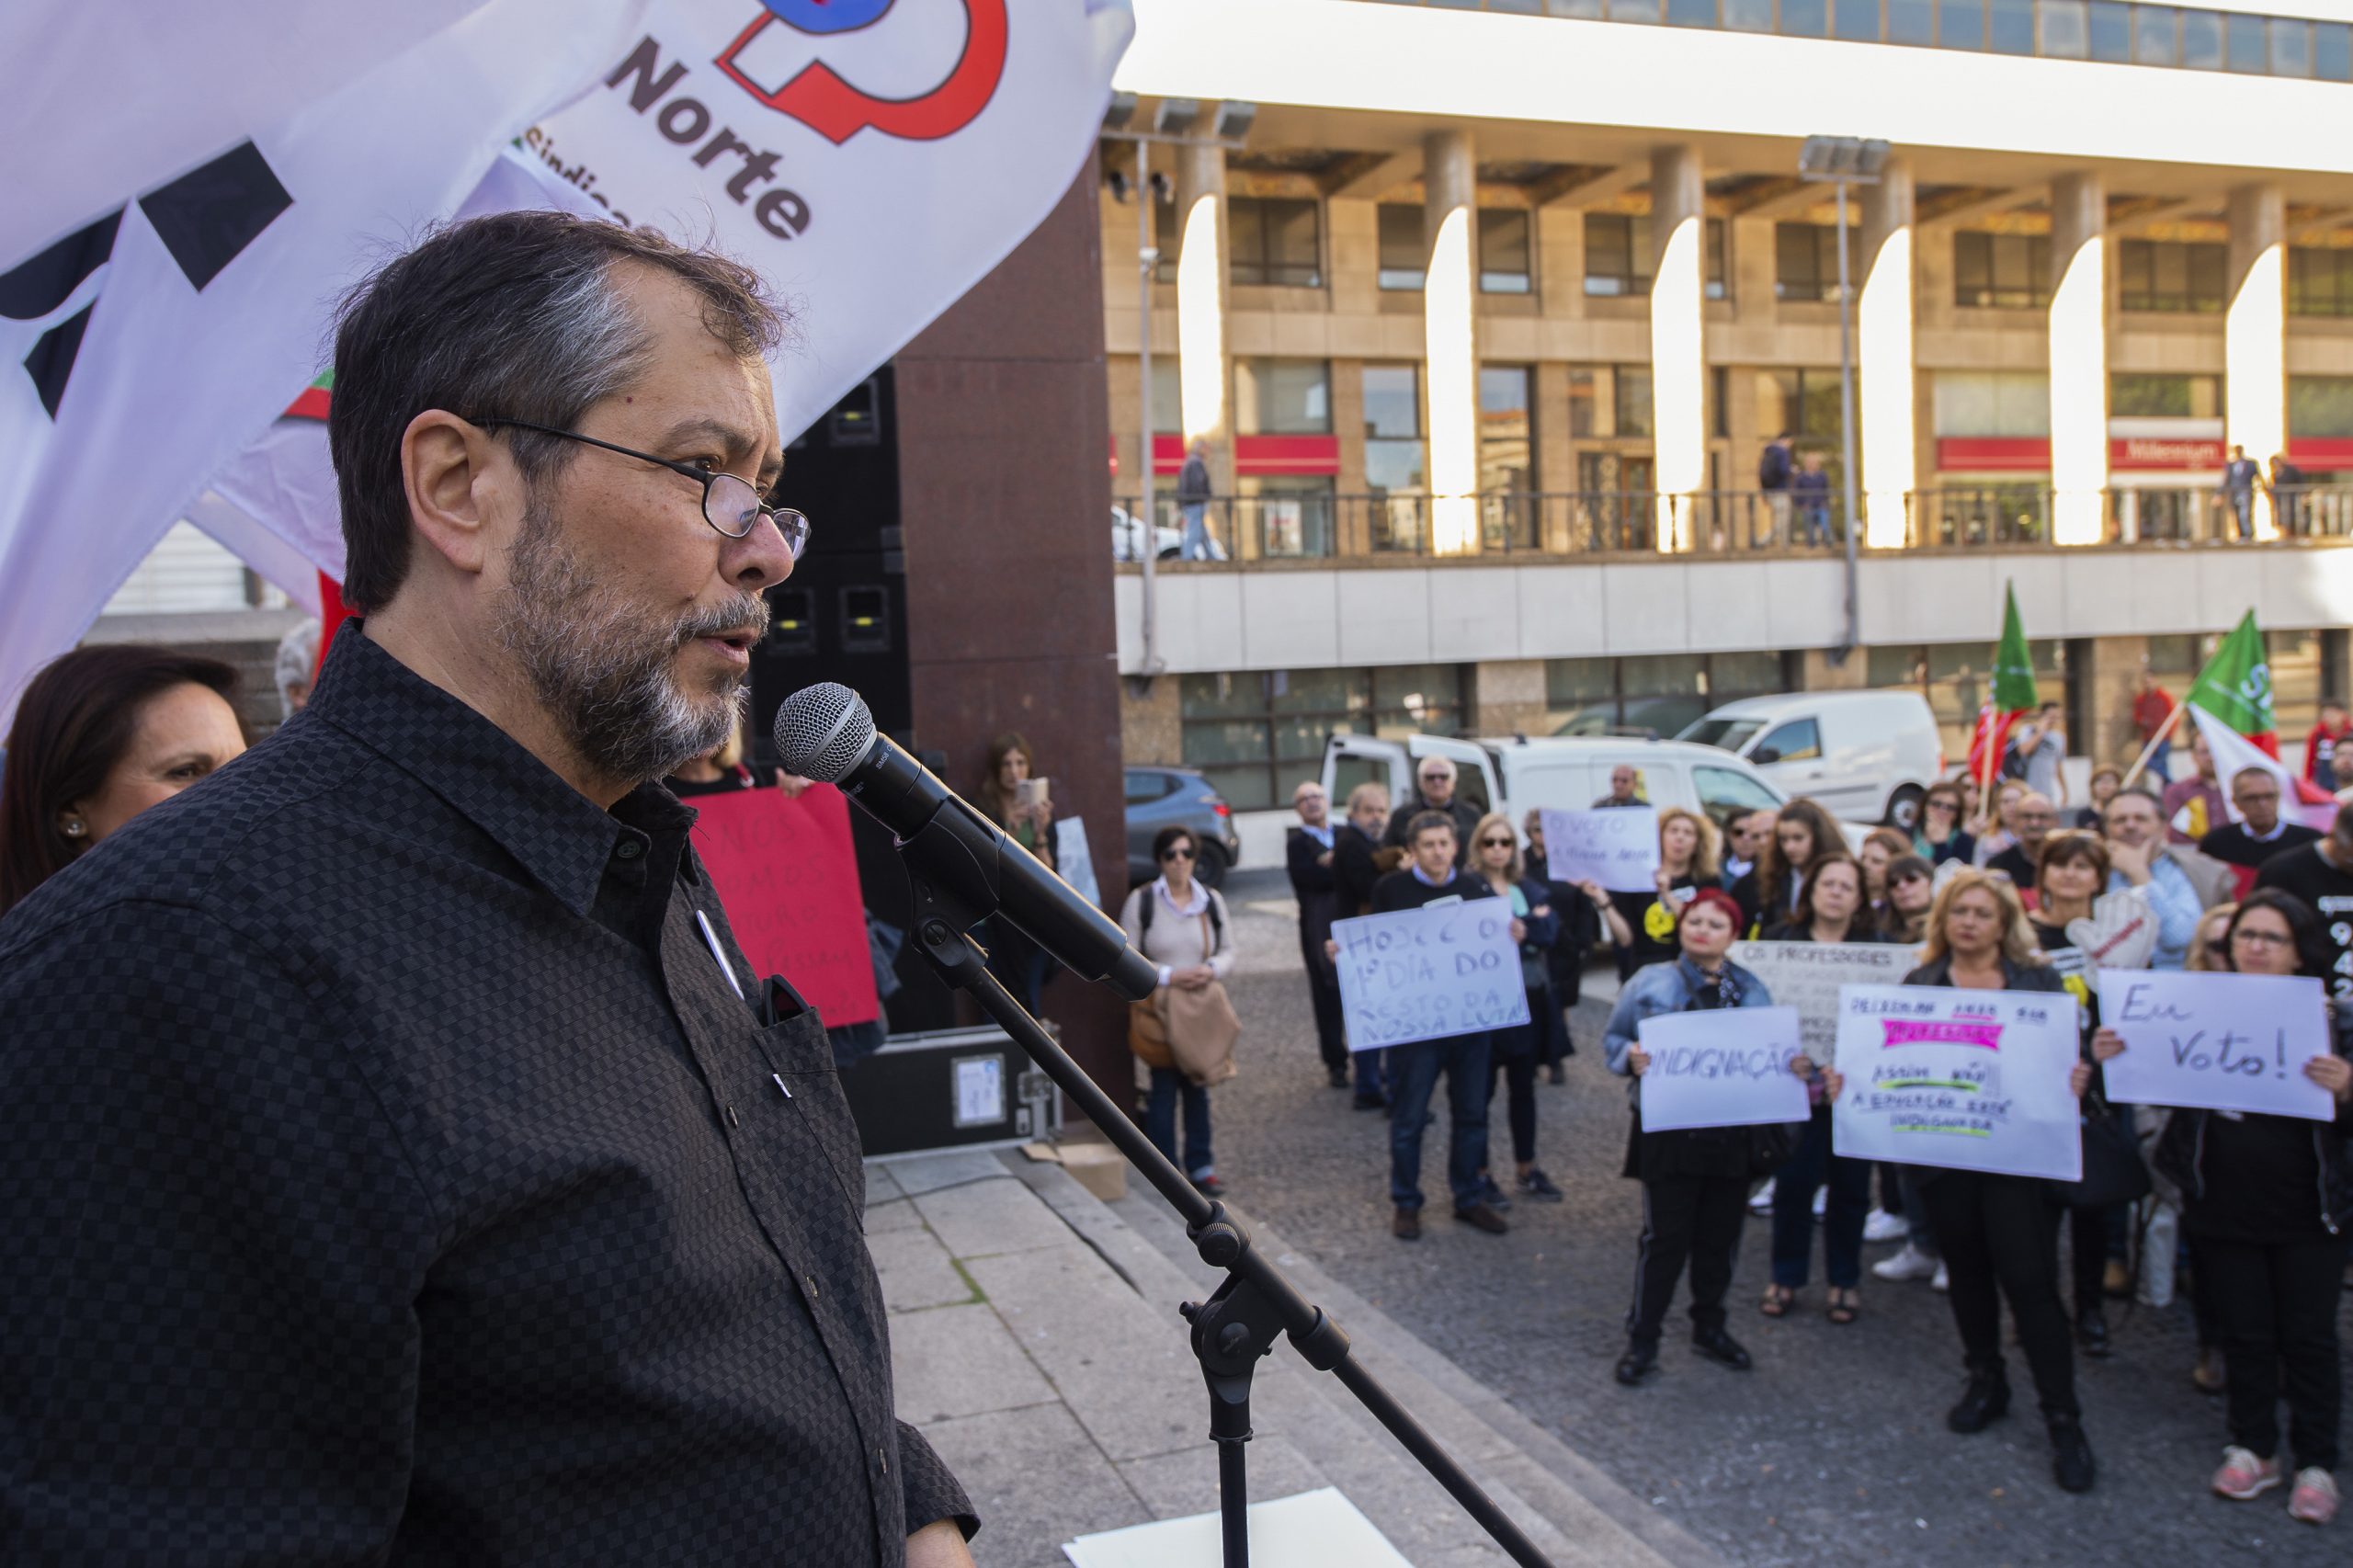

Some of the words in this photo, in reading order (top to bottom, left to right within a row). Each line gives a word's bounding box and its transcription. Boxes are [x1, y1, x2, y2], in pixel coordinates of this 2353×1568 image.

[604, 34, 811, 241] Norte
[875, 751, 890, 769] SM58
[724, 851, 824, 897] OMOS
[1478, 917, 1497, 941] O
[1384, 953, 1436, 990] DIA
[1455, 949, 1501, 977] DO
[1351, 992, 1452, 1022] RESTO
[1464, 987, 1501, 1009] DA
[2120, 983, 2193, 1022] Eu
[1362, 1015, 1448, 1043] NOSSA
[2169, 1027, 2287, 1080] Voto!
